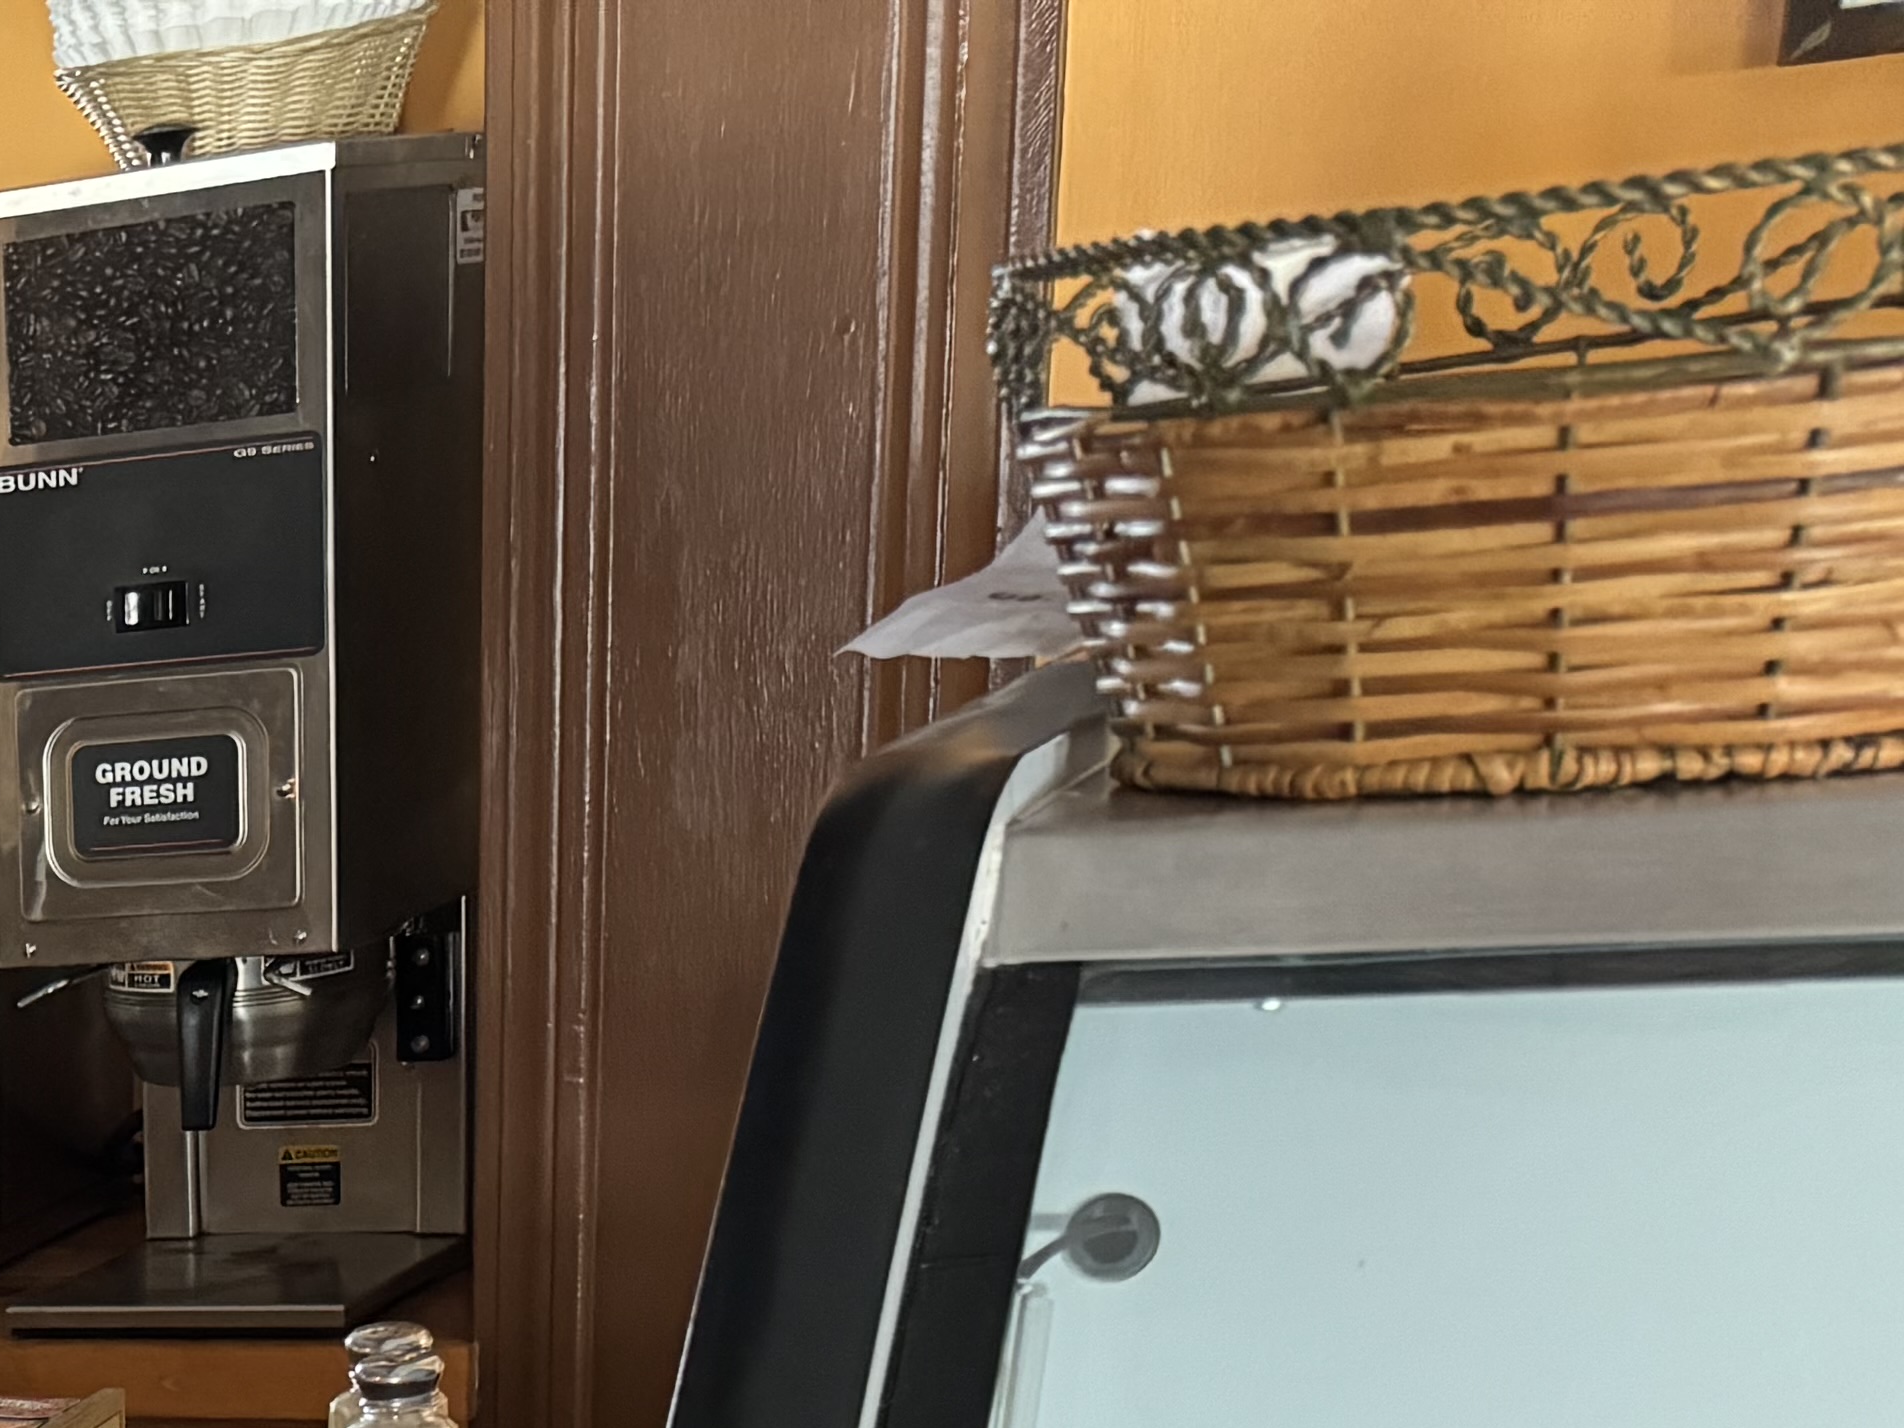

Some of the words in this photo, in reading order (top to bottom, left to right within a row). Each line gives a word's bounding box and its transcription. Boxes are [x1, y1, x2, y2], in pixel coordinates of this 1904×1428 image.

[261, 441, 314, 455] SERIES
[94, 756, 208, 784] GROUND
[109, 782, 195, 808] FRESH
[103, 815, 119, 826] For
[121, 814, 142, 825] Your
[144, 810, 199, 824] Satisfaction
